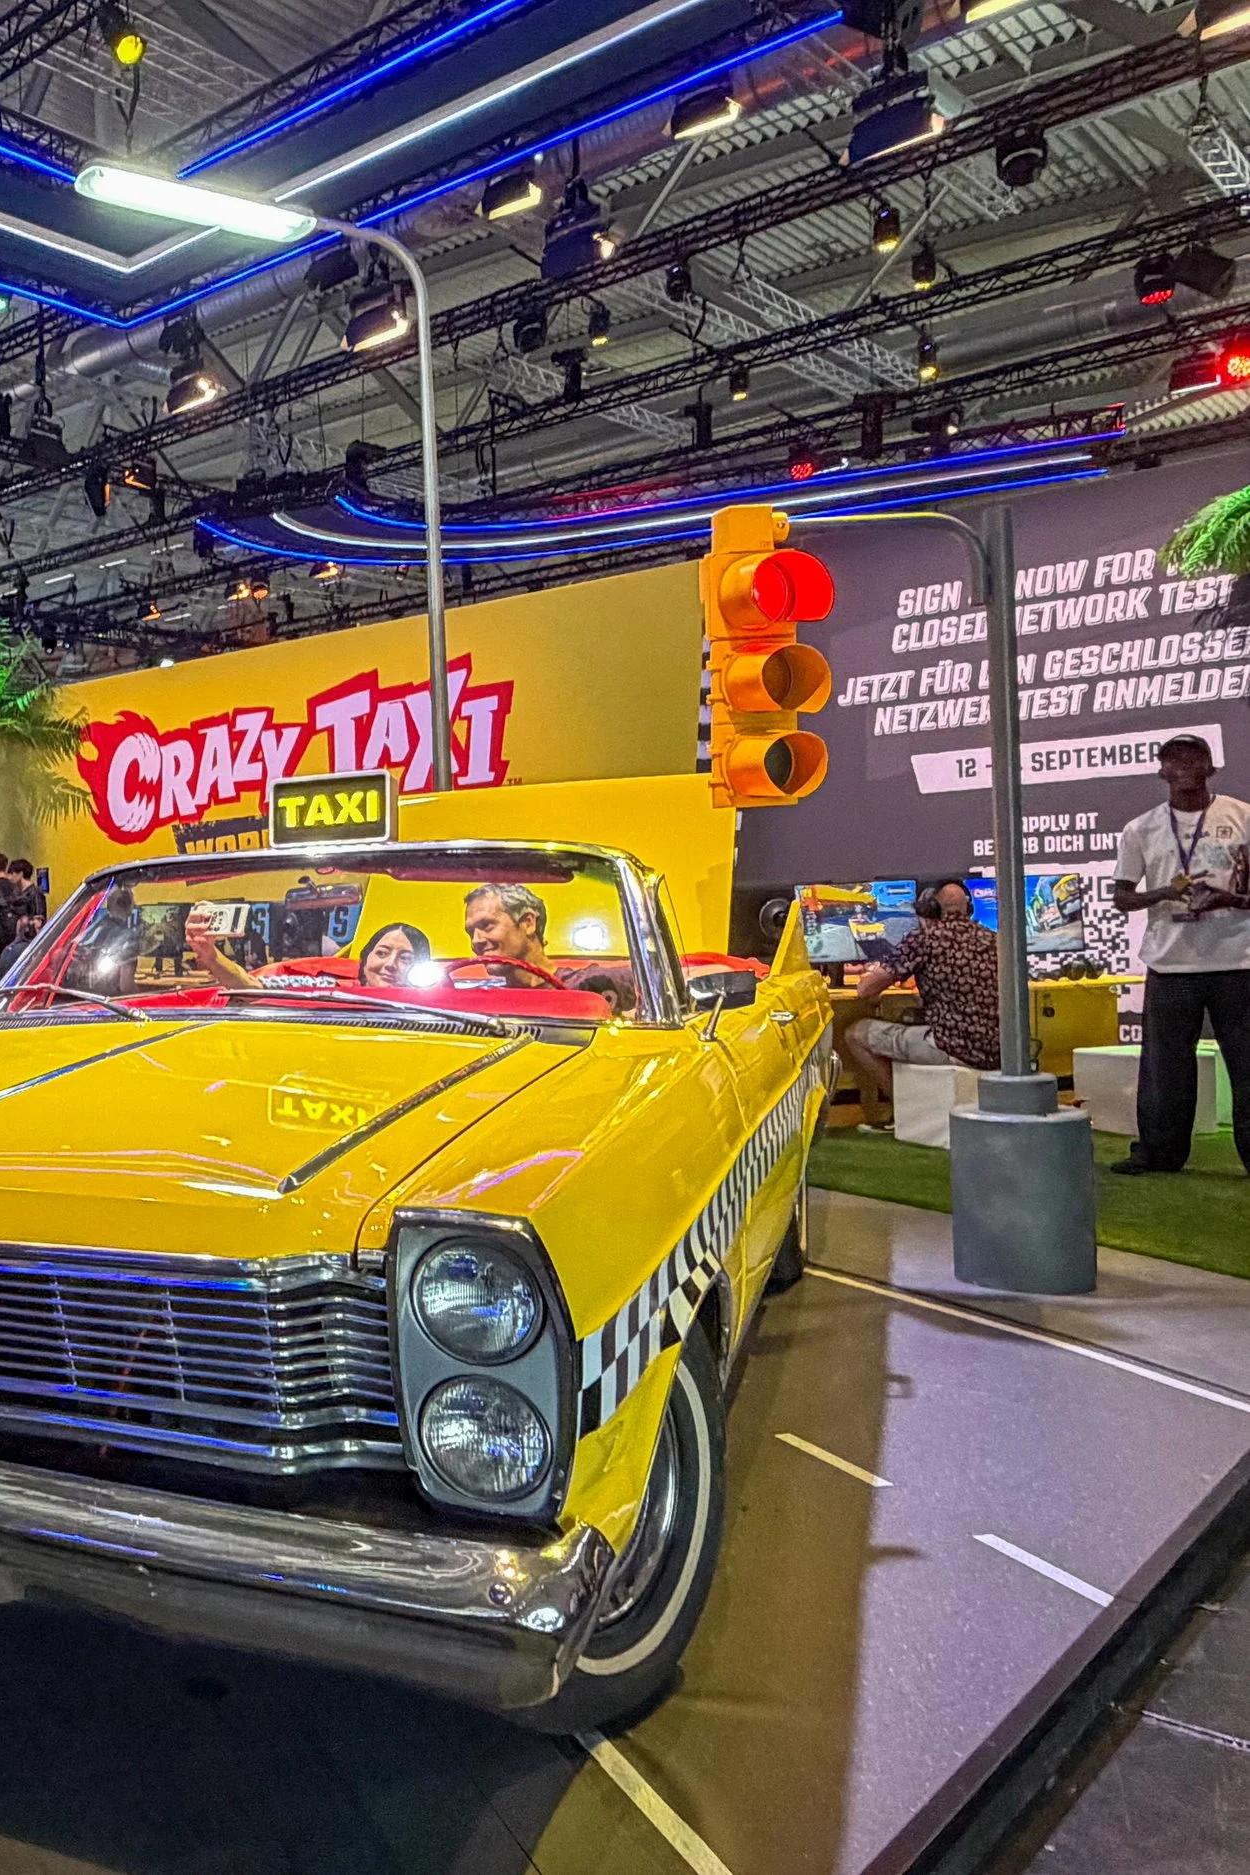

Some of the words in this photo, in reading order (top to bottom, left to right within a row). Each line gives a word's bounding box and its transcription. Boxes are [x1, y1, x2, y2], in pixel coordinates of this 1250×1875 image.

[897, 580, 963, 619] SIGN
[1014, 559, 1089, 601] NOW
[1093, 548, 1157, 588] FOR
[1158, 573, 1239, 616] TEST
[837, 669, 916, 707] JETZT
[918, 659, 973, 697] FÜR
[873, 683, 1089, 736] NETZWERTEST
[107, 710, 302, 834] CRAZY
[315, 667, 499, 792] TAXI
[956, 757, 977, 779] 12
[277, 789, 381, 828] TAXI
[1075, 812, 1098, 831] AT
[1044, 835, 1084, 853] DICH
